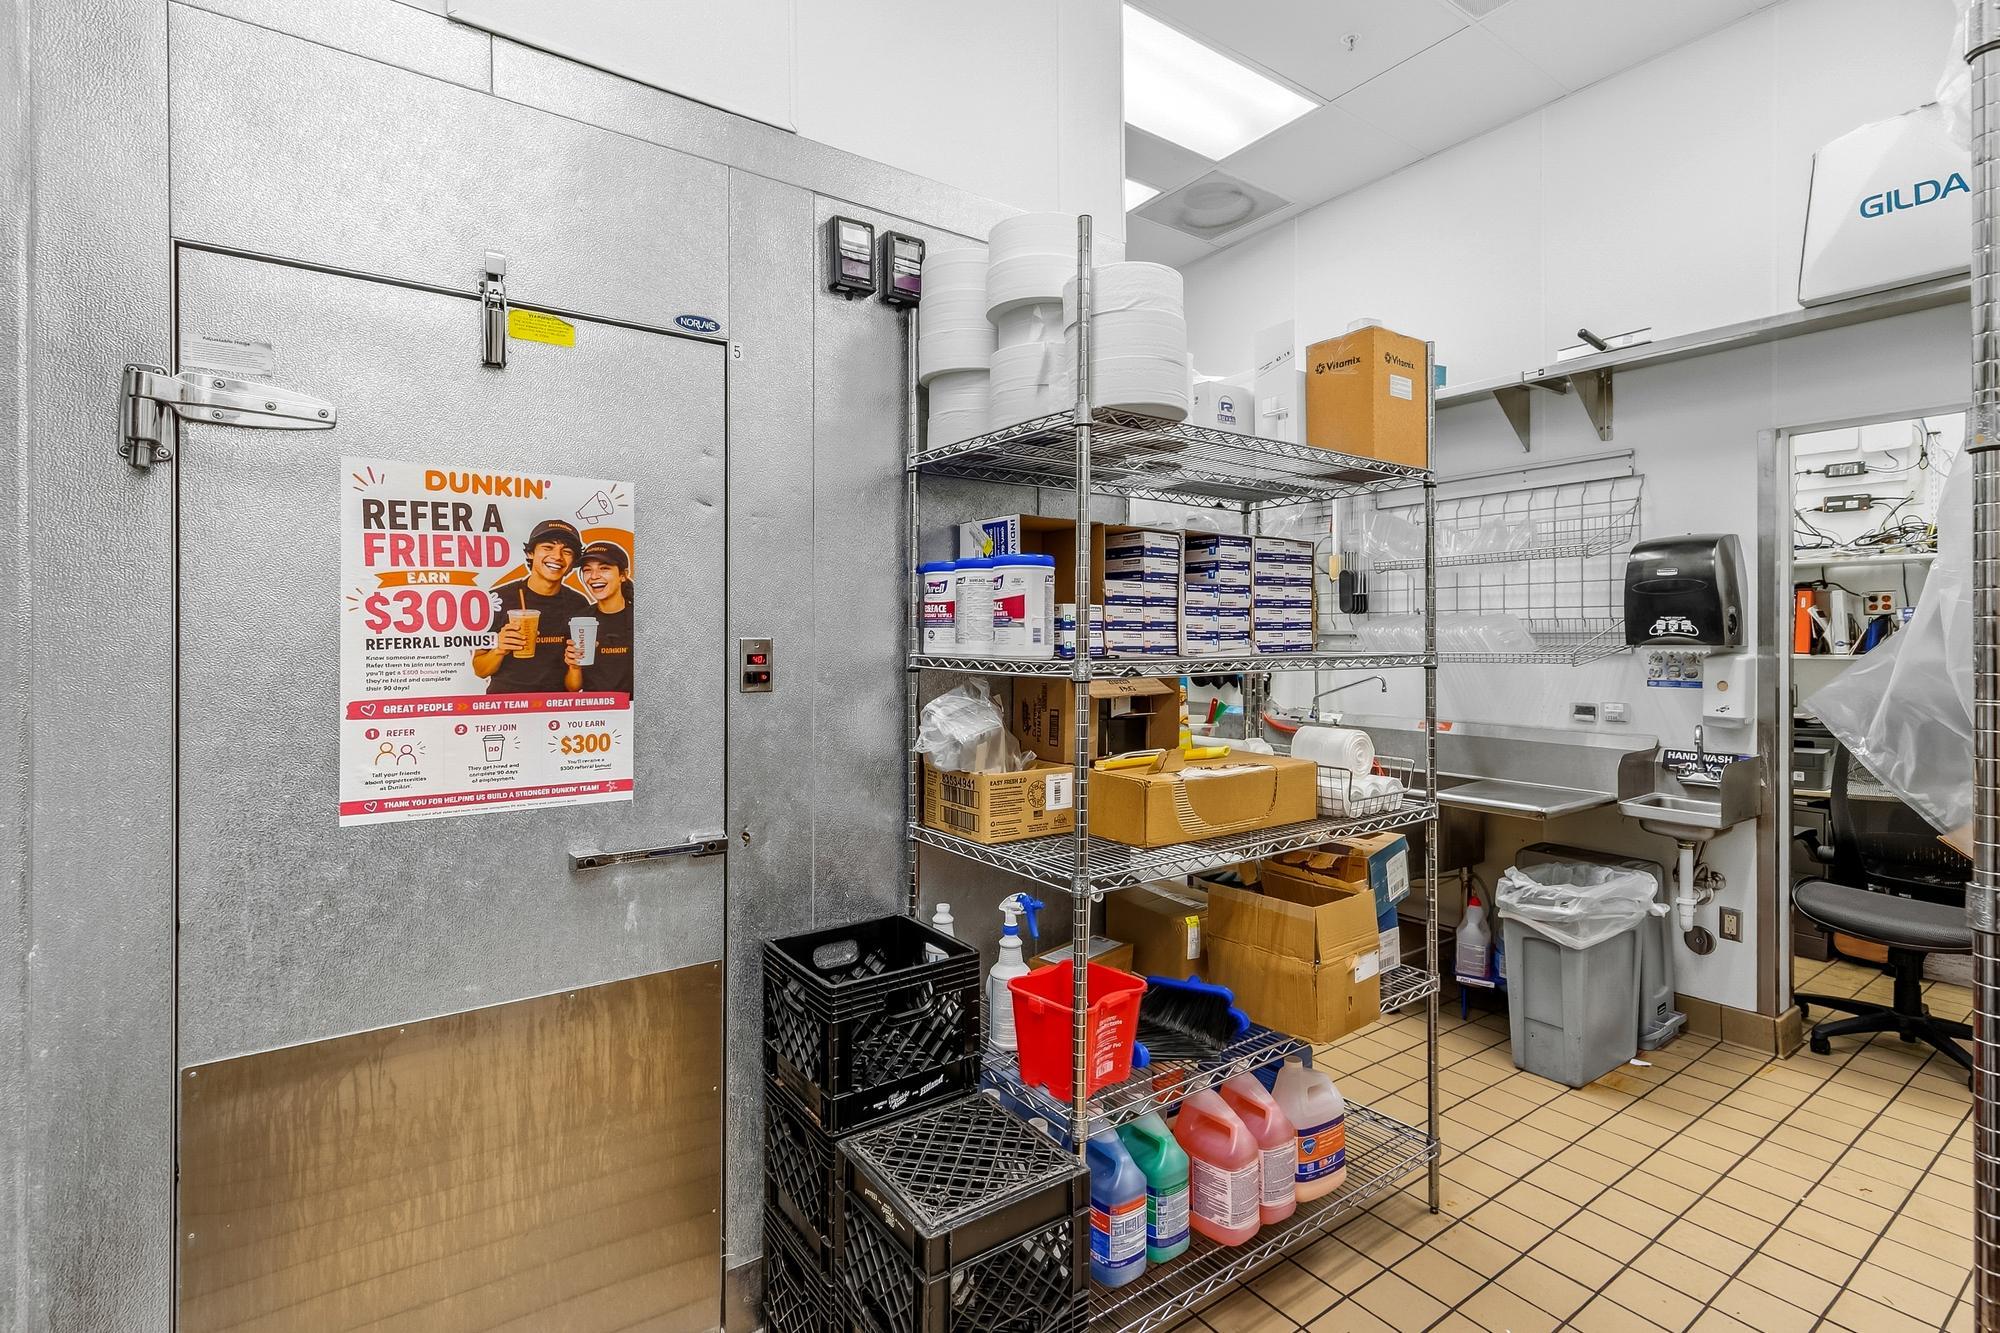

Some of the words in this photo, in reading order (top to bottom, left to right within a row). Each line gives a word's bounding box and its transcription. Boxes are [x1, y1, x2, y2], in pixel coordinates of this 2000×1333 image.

[1860, 172, 1971, 219] GILDA
[734, 346, 741, 359] 5
[1326, 356, 1361, 370] Vitamix
[1392, 356, 1415, 370] Vitamix
[425, 470, 551, 499] DUNKIN'
[363, 499, 473, 532] REFER
[483, 503, 504, 532] A
[363, 533, 510, 568] FRIEND
[407, 572, 450, 585] EARN
[365, 590, 490, 634] $300
[366, 636, 440, 650] REFERRAL
[444, 634, 496, 648] BONUS!
[383, 704, 415, 714] GREAT
[417, 702, 453, 713] PEOPLE
[472, 701, 502, 710] GREAT
[504, 700, 529, 709] TEAM
[546, 698, 573, 707] GREAT
[575, 697, 615, 706] REWARDS
[475, 725, 497, 733] THEY
[498, 724, 517, 732] JOIN
[567, 721, 583, 729] YOU
[585, 720, 605, 728] EARN
[386, 729, 415, 737] REFER
[560, 733, 611, 755] $300
[1667, 751, 1698, 761] HAND
[384, 800, 409, 809] THANK
[411, 799, 426, 807] YOU
[445, 795, 474, 804] HELPING
[516, 789, 550, 797] STRONGER
